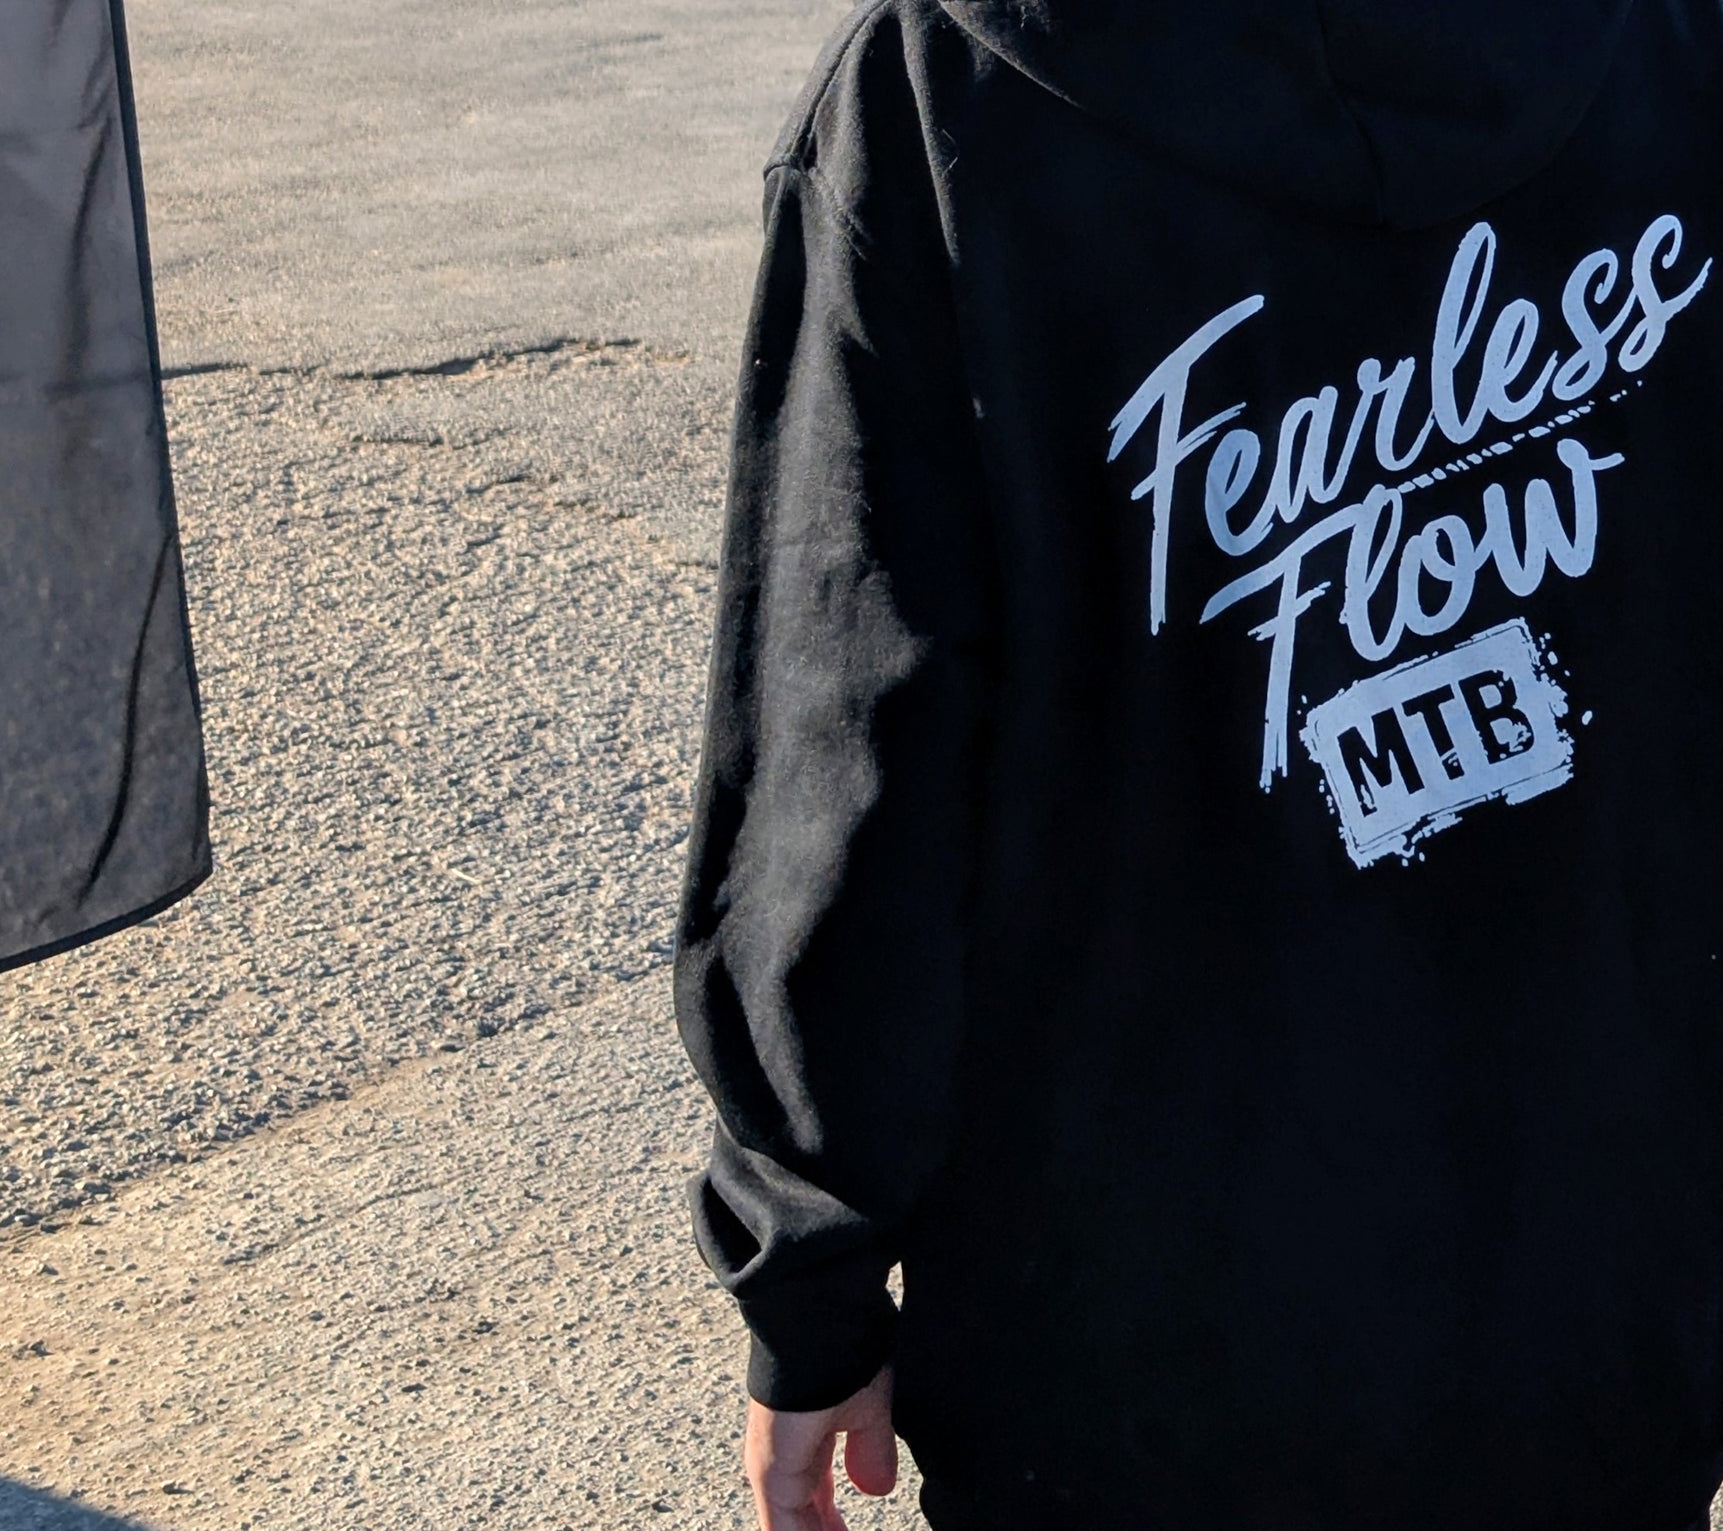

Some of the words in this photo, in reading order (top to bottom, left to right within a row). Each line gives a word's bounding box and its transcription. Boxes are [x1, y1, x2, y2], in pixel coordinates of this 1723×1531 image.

[1107, 214, 1713, 635] Fearless
[1199, 438, 1625, 793] Flow
[1335, 667, 1538, 819] MTB
